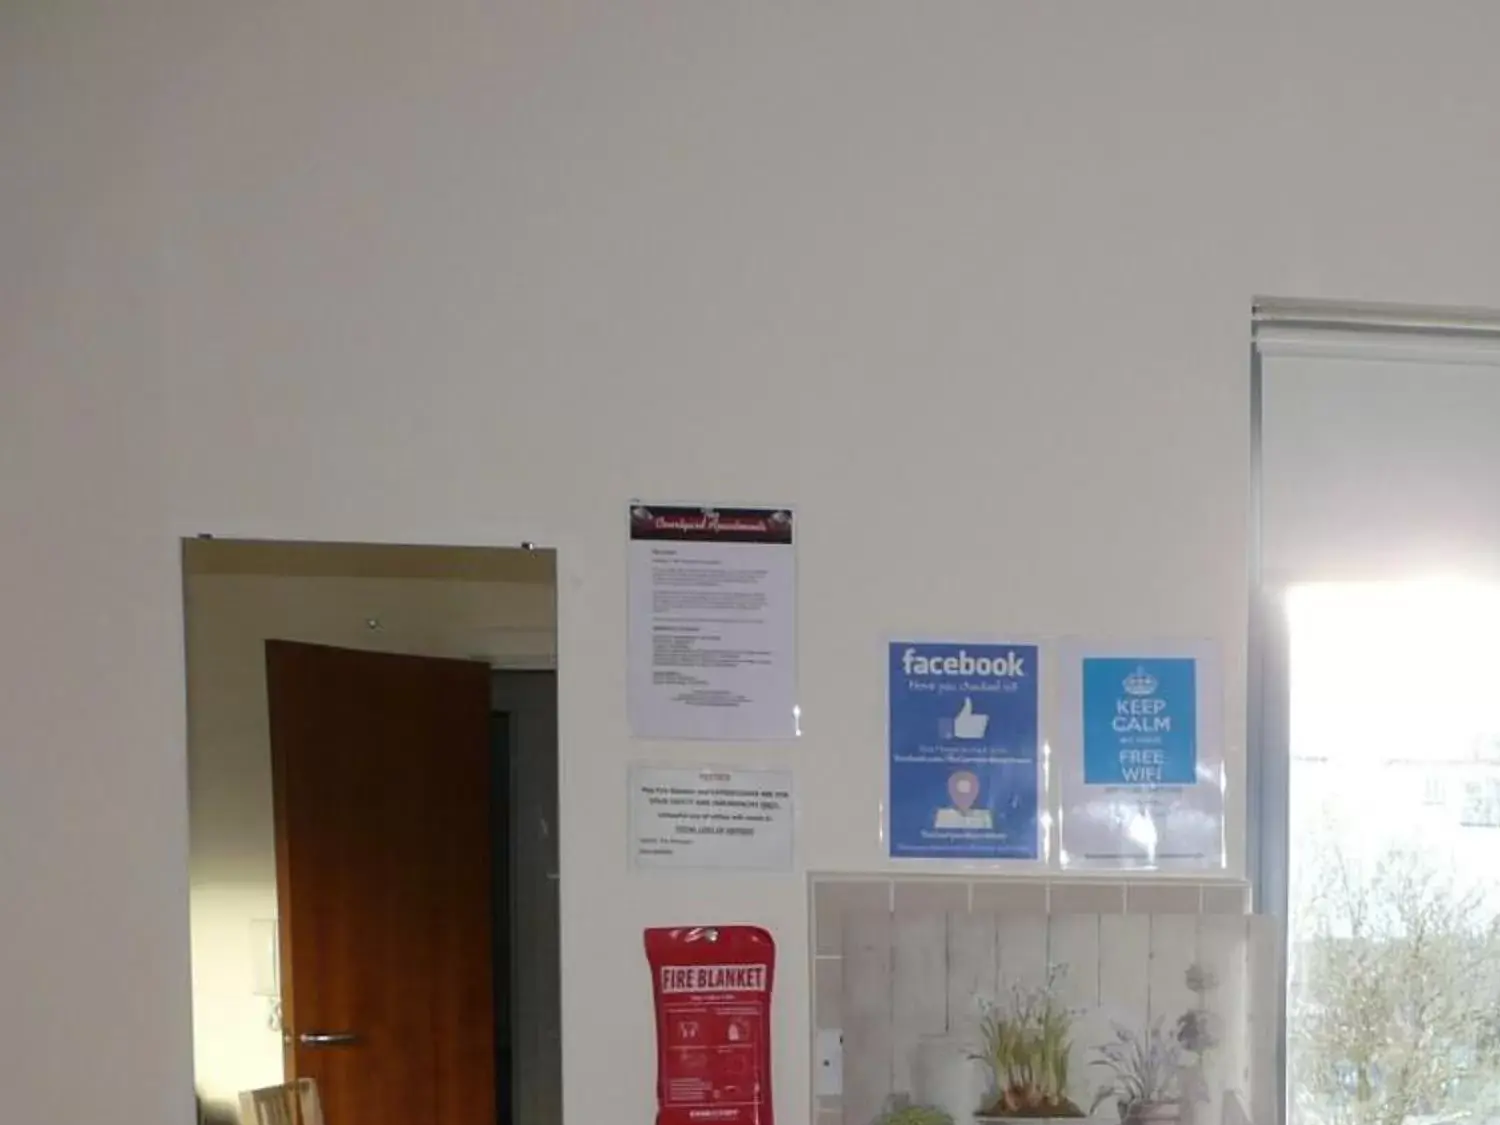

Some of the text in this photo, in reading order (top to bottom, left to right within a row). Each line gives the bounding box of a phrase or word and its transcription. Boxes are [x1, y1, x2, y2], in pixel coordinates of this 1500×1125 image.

[903, 648, 1024, 676] facebook
[1116, 699, 1166, 715] KEEP
[1112, 717, 1171, 732] CALM
[1120, 749, 1165, 765] FREE
[663, 967, 763, 989] FIRE BLANKET
